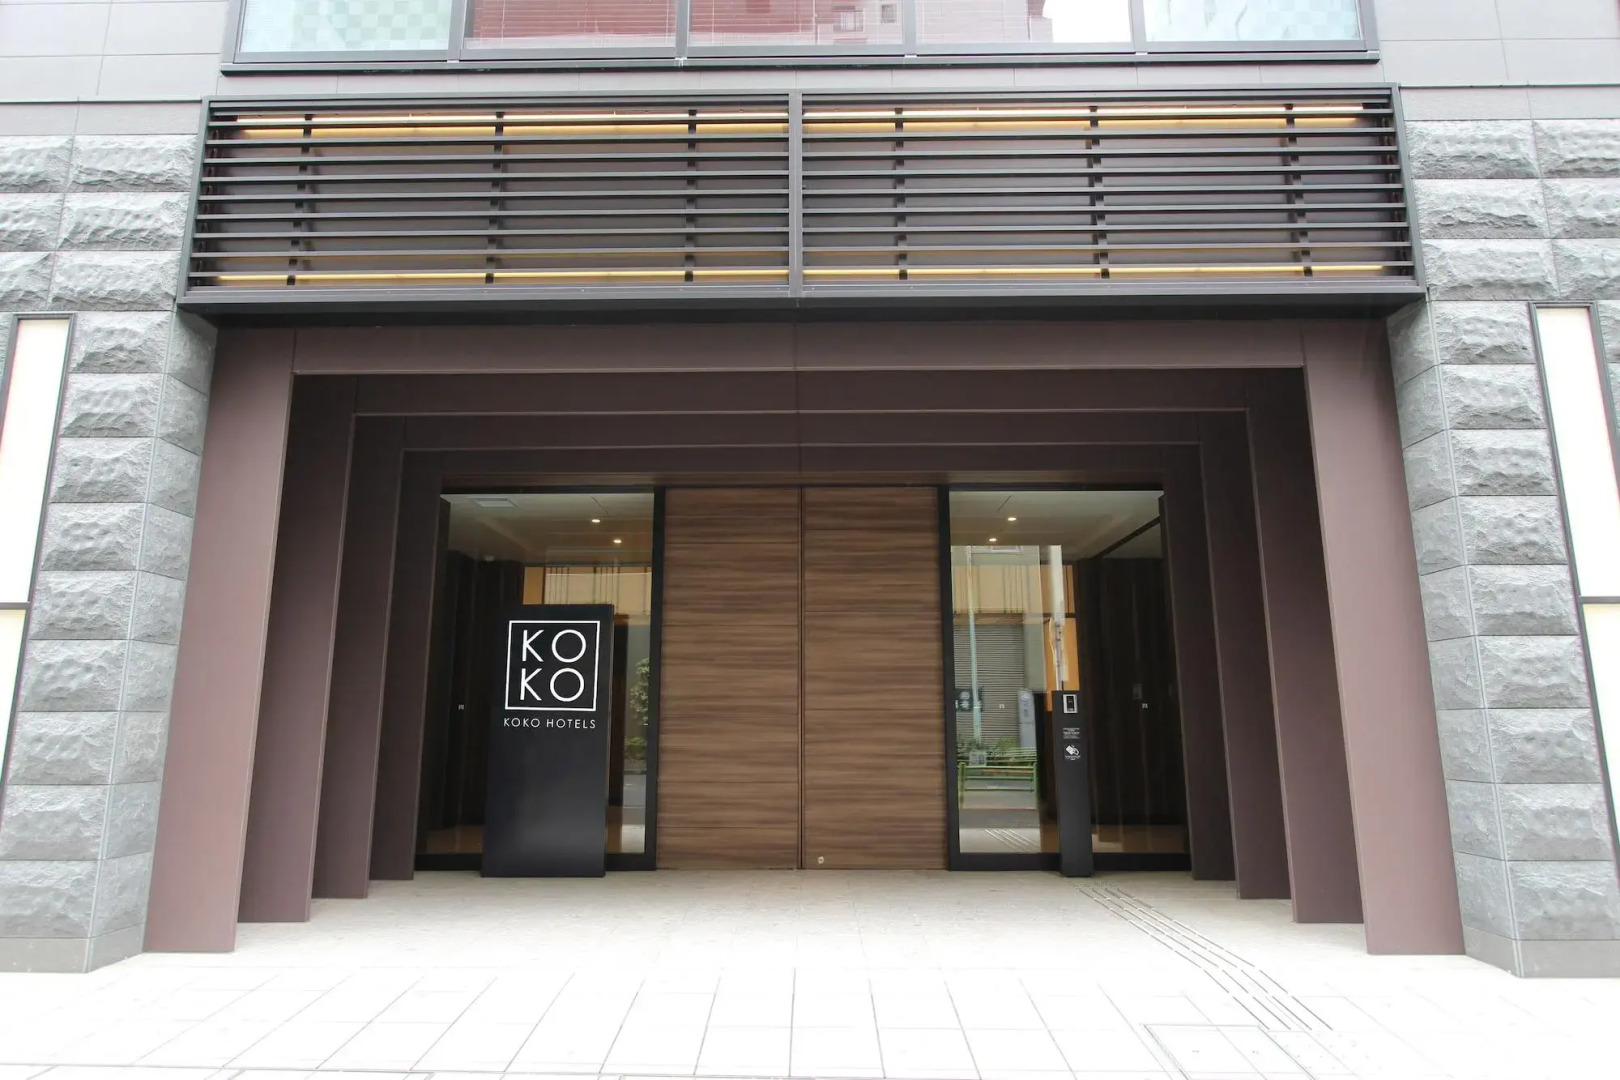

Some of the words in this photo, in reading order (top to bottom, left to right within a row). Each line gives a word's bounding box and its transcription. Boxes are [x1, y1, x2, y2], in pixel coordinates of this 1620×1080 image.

[522, 629, 587, 663] KO
[520, 667, 585, 702] KO
[503, 717, 541, 728] KOKO
[546, 718, 596, 729] HOTELS
